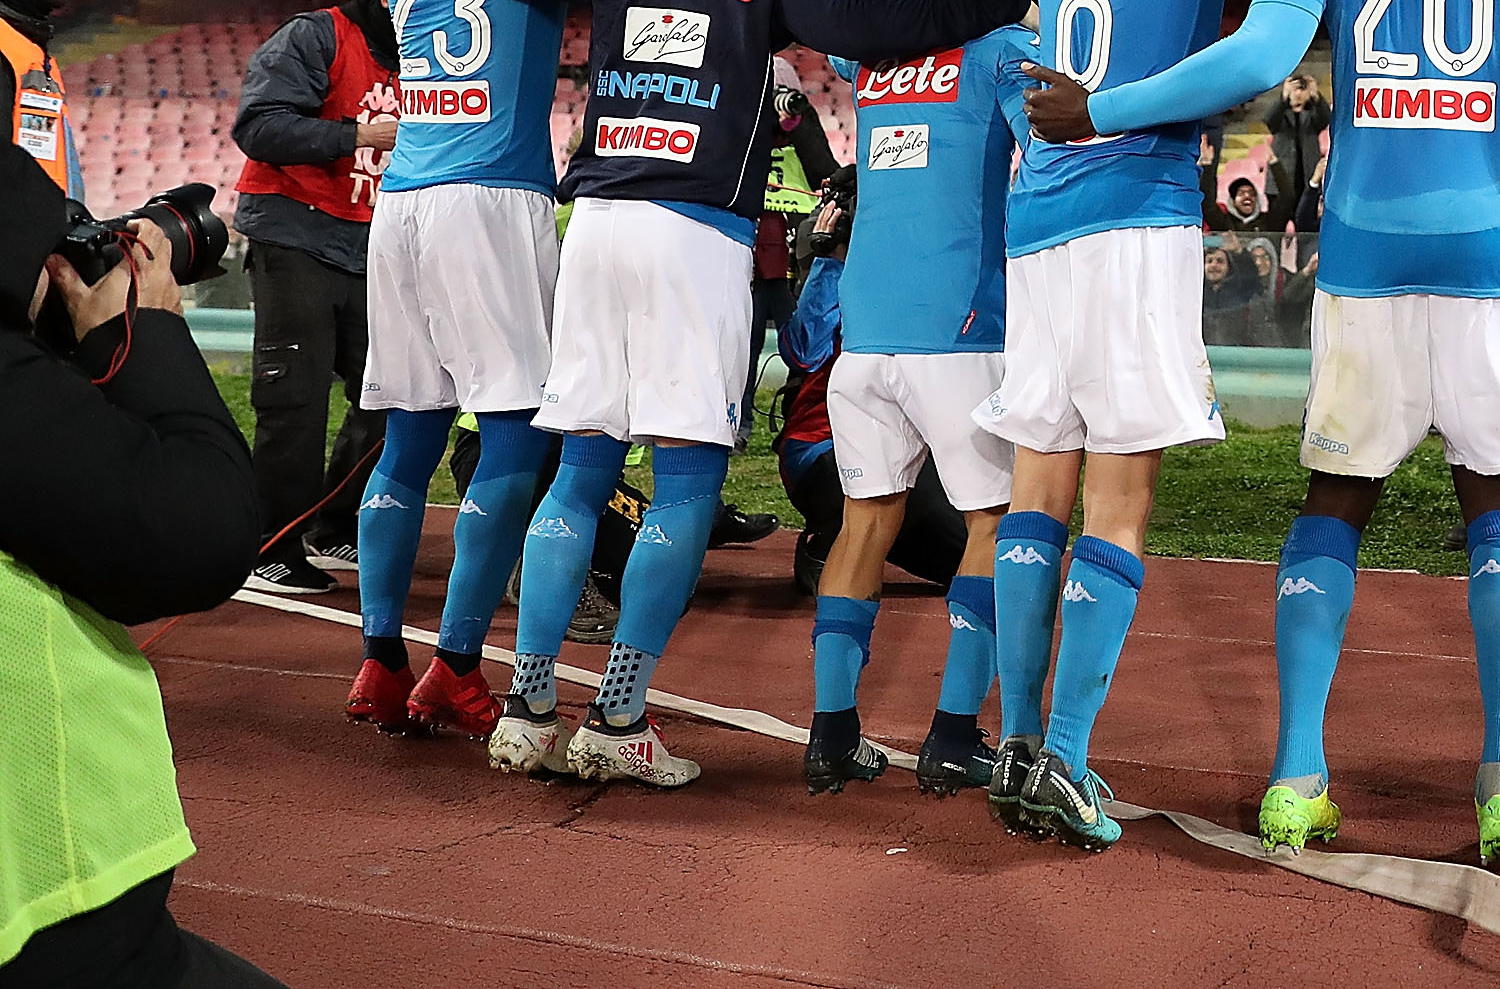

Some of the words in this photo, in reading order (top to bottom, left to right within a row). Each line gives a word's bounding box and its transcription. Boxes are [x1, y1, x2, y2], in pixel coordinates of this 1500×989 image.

[624, 18, 706, 61] Garofalo
[597, 70, 609, 97] SSC
[608, 70, 721, 109] NAPOLI
[856, 56, 960, 101] Lete
[399, 88, 487, 116] KIMBO
[1356, 87, 1493, 123] KIMBO
[599, 124, 695, 155] KIMBO
[868, 130, 928, 169] Garofalo
[1309, 432, 1349, 454] Kappa
[841, 468, 864, 480] ppa
[618, 746, 655, 778] adidas
